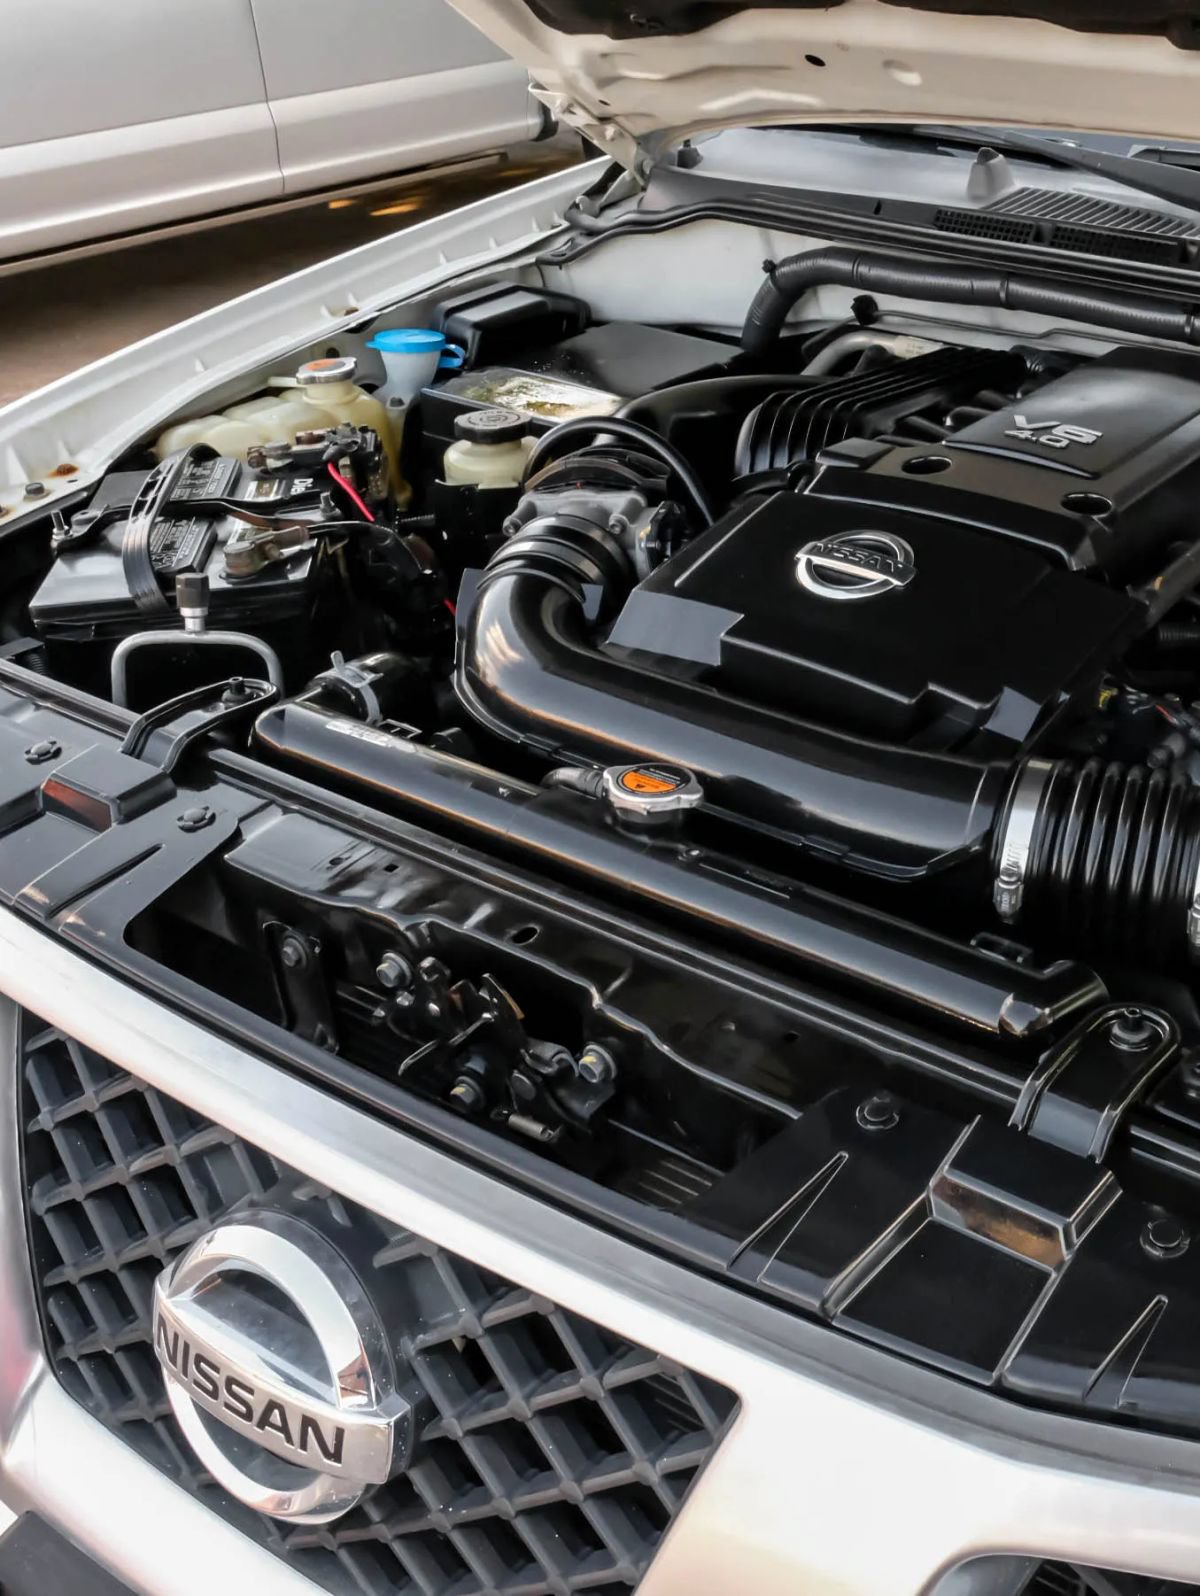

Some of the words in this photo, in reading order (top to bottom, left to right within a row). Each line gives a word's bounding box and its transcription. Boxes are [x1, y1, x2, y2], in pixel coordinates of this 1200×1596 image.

[1004, 430, 1070, 448] 4.0
[1014, 415, 1103, 444] V6
[808, 543, 895, 573] NISSAN
[157, 1311, 345, 1465] NISSAN
